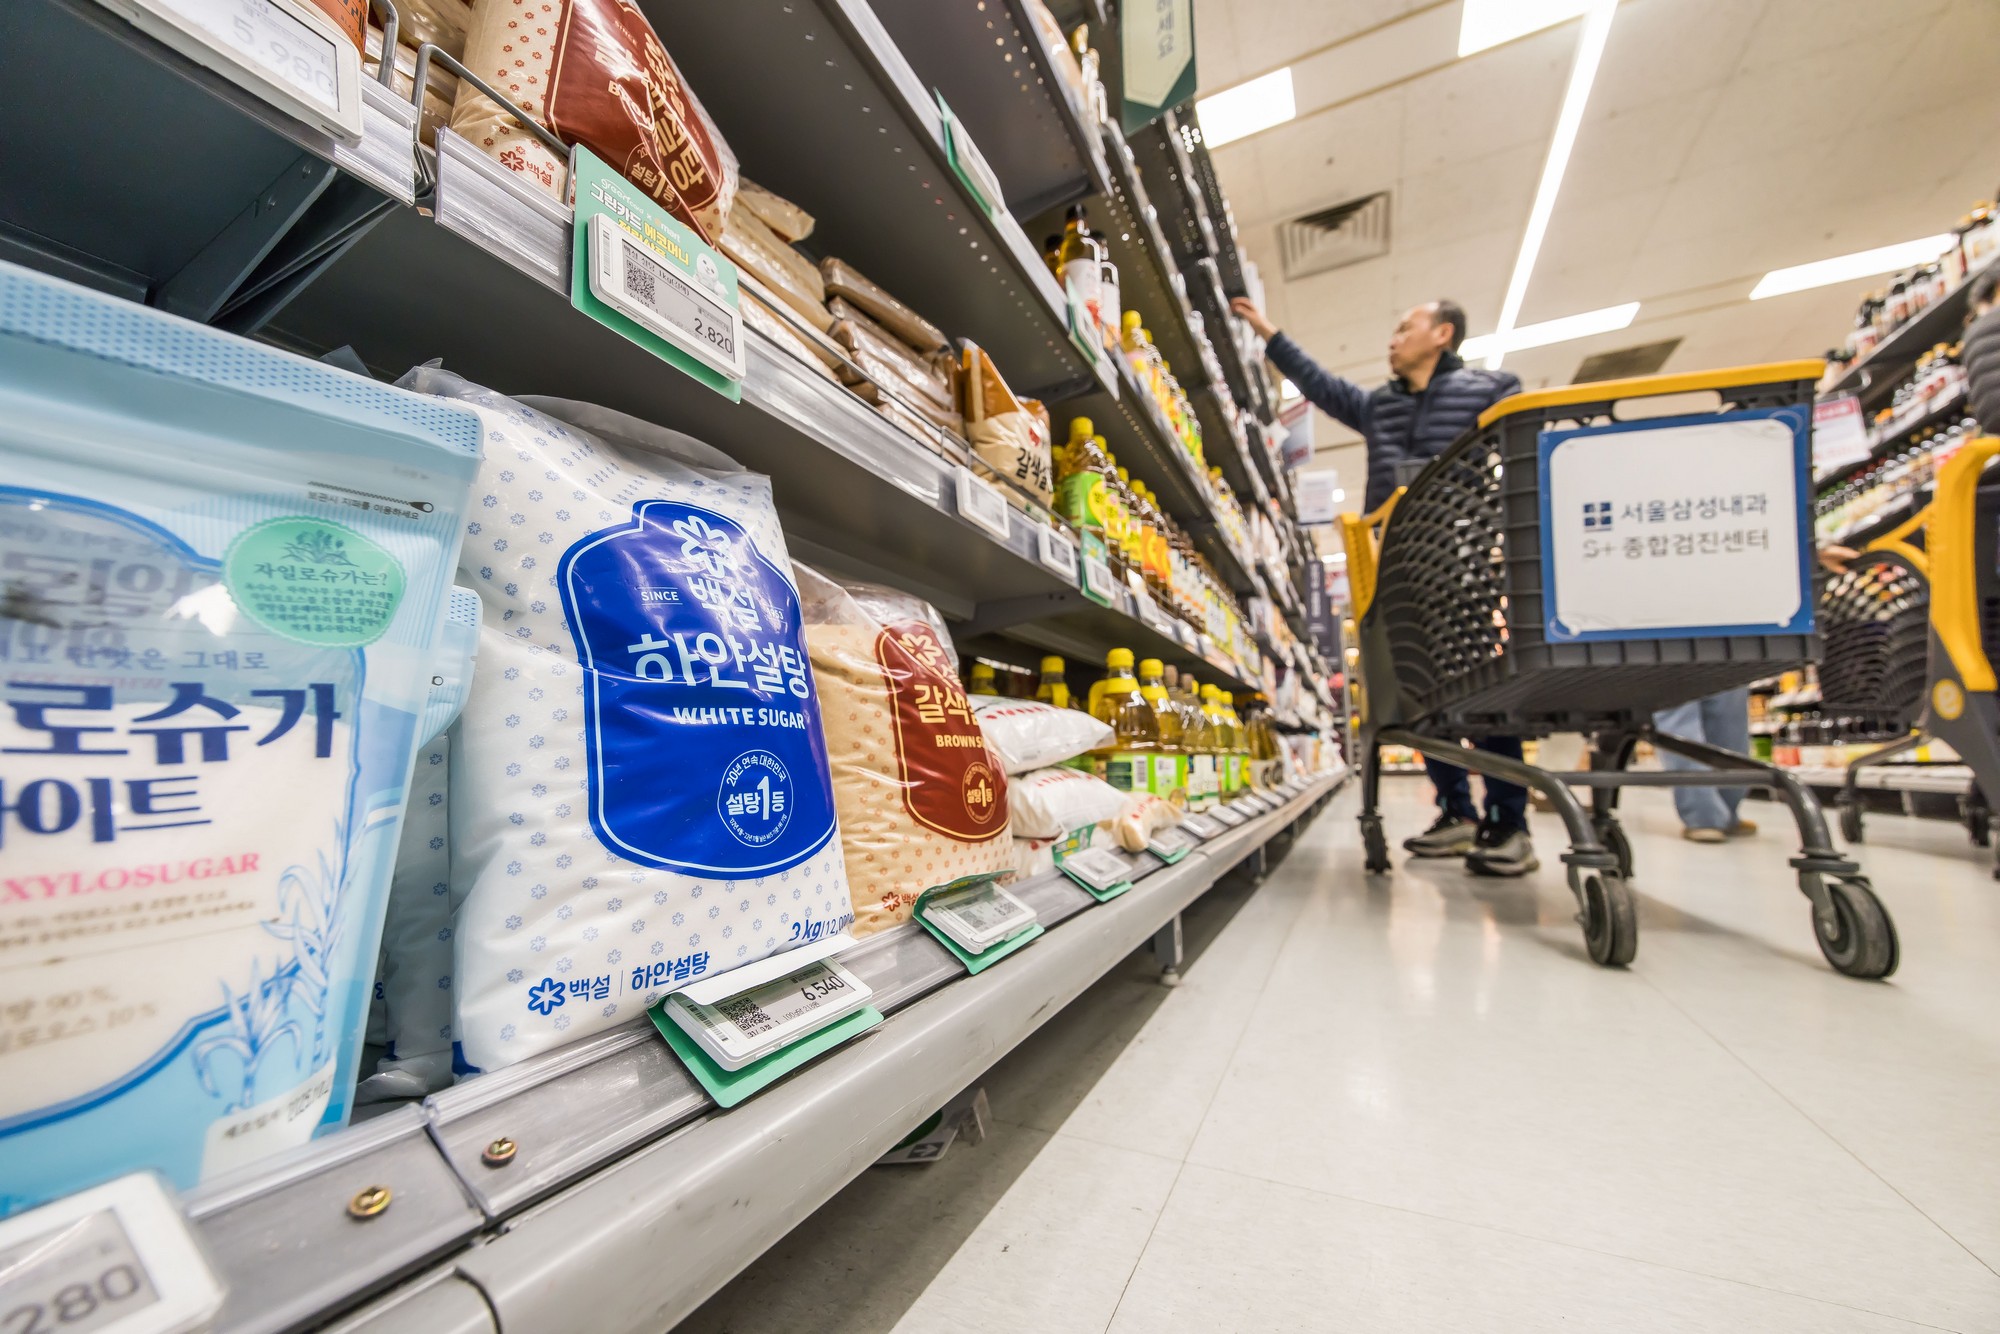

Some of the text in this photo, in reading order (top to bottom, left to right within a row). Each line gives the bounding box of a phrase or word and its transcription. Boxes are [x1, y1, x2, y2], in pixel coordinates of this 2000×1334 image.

[526, 161, 552, 188] 백설
[590, 181, 643, 231] 그린카드
[643, 220, 690, 267] 에코머니
[1621, 493, 1767, 523] 서울삼성내과
[1583, 528, 1770, 560] S+ 종합검진센터
[253, 563, 388, 586] 자일로슈가는?
[640, 590, 680, 602] SINCE
[686, 576, 763, 632] 백설
[180, 649, 271, 671] 그대로
[627, 631, 810, 699] 하얀설탕
[672, 706, 806, 730] WHITE SUGAR
[726, 754, 787, 788] 20년 연속 대한민국
[0, 774, 213, 851] 이트
[725, 775, 785, 821] 설탕1등
[0, 852, 261, 905] XYLOSUGAR
[569, 950, 711, 1002] 백설 하얀설탕
[800, 975, 845, 1001] 6,540
